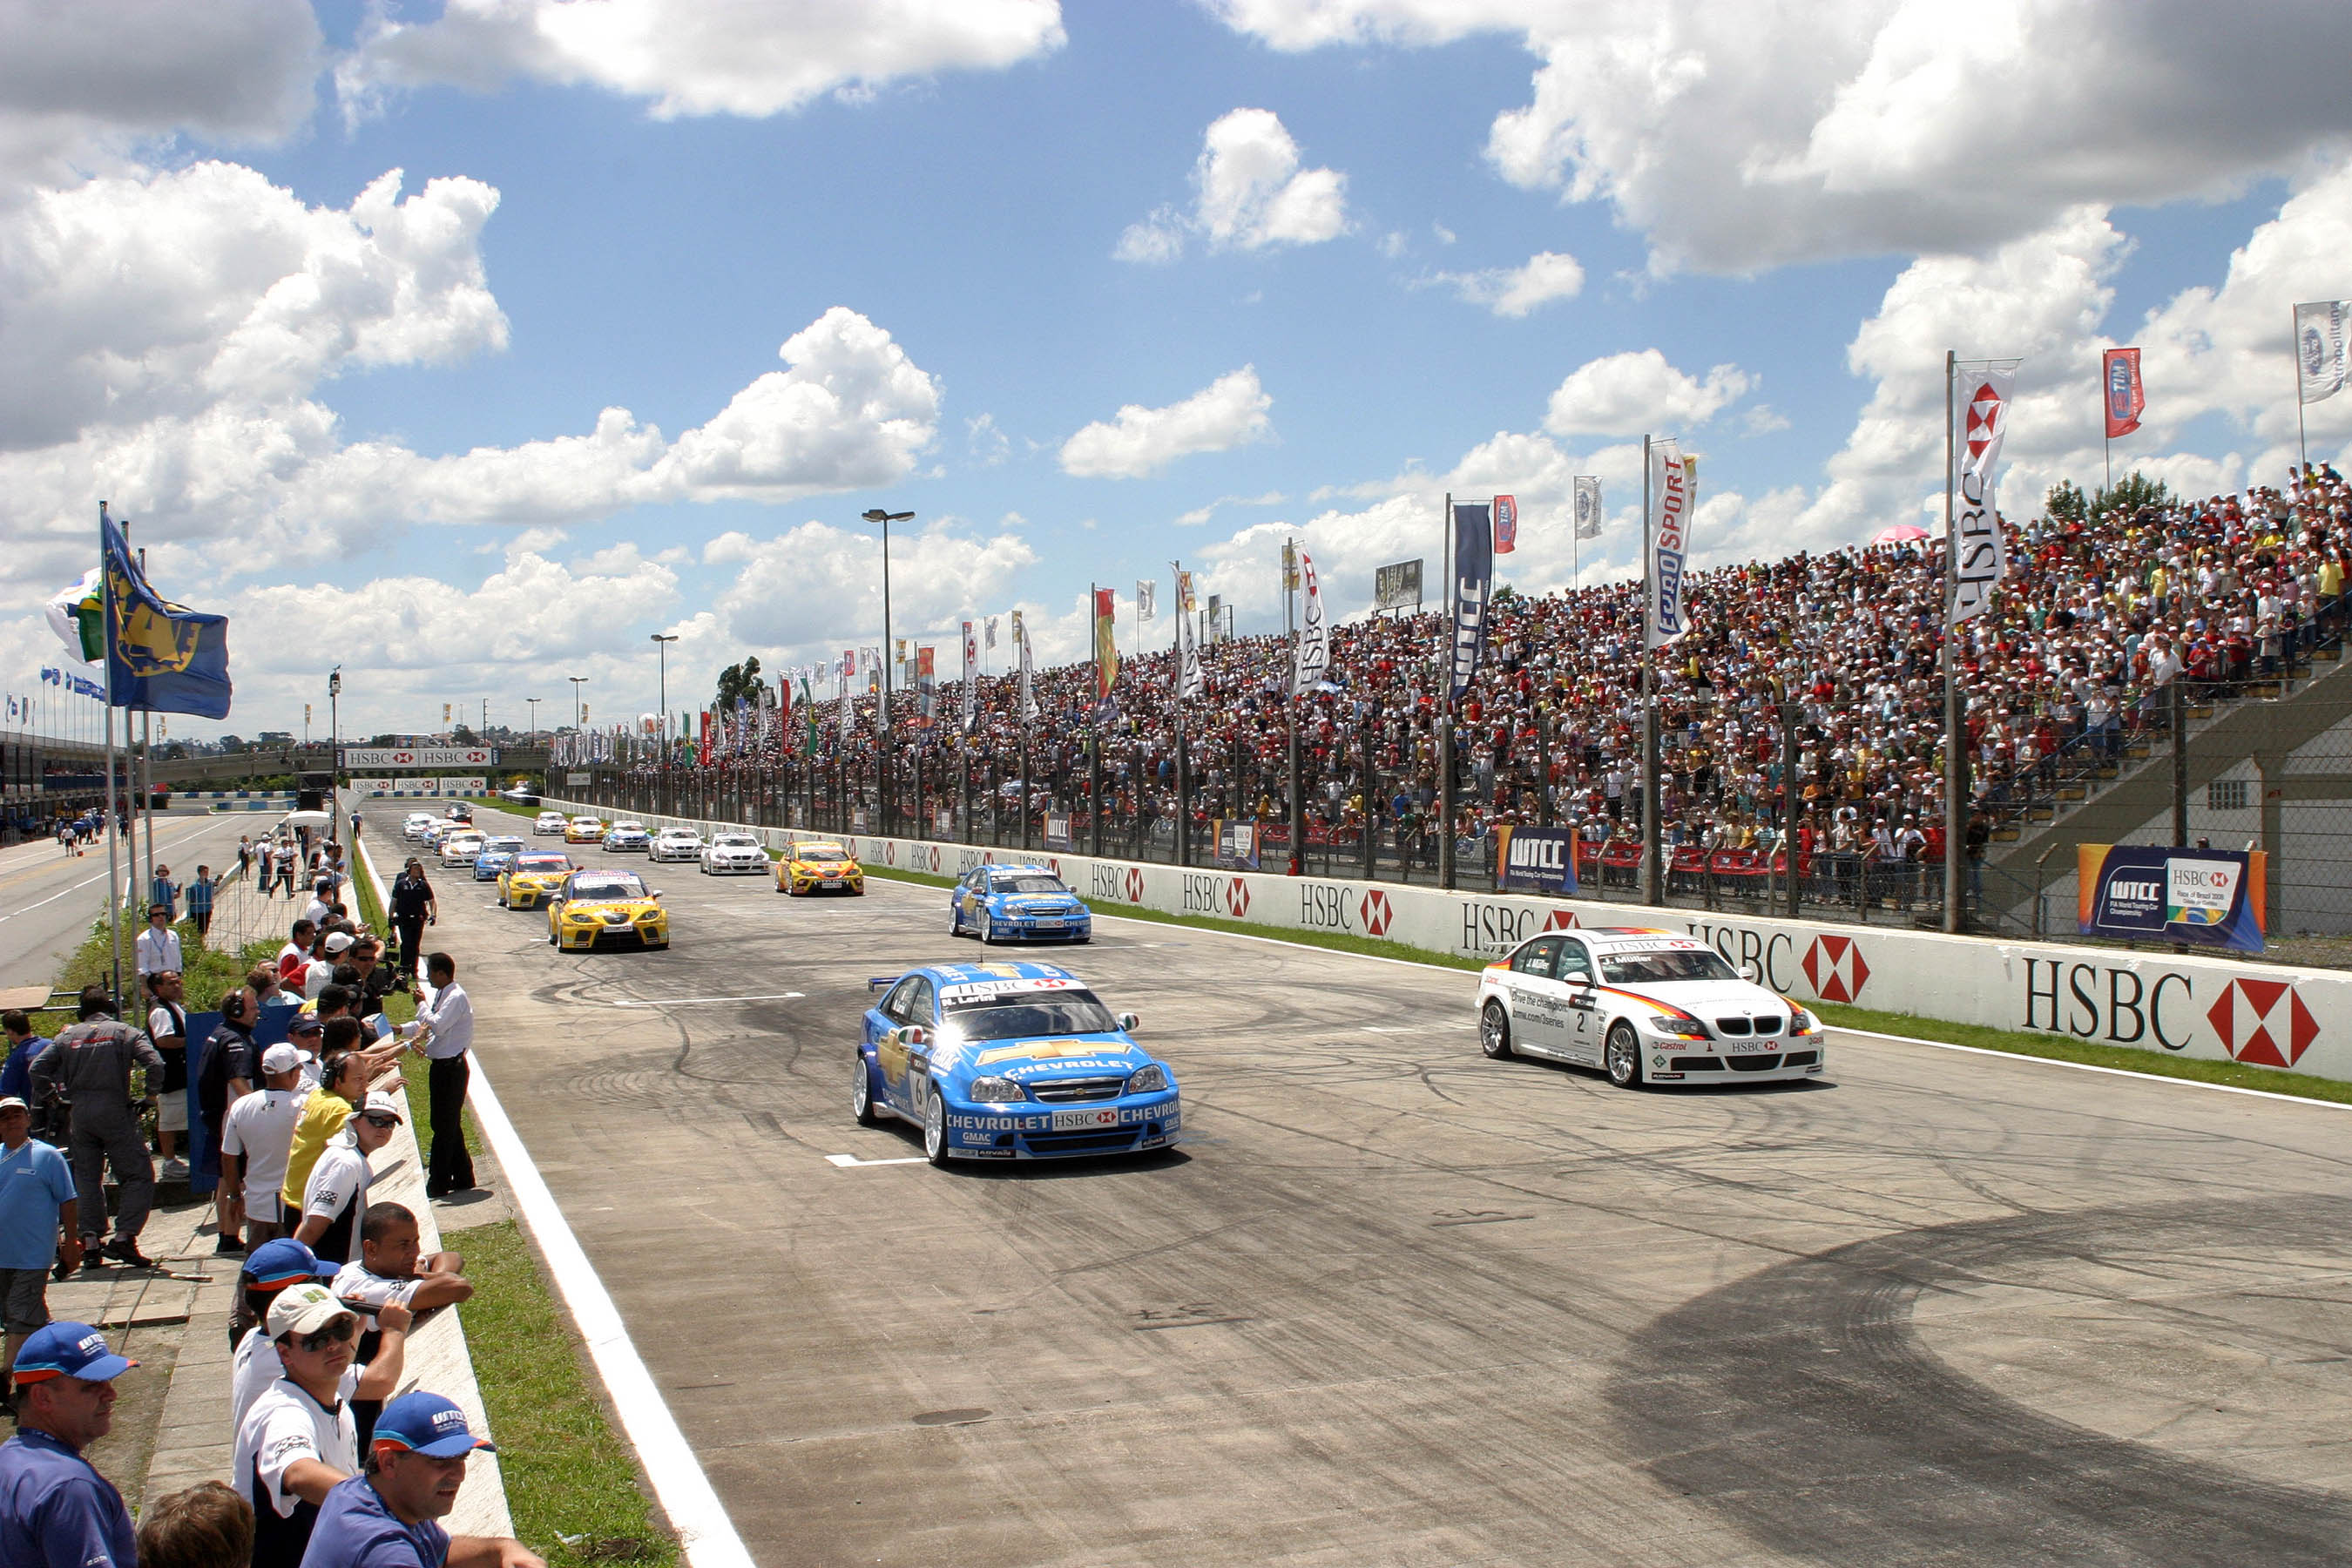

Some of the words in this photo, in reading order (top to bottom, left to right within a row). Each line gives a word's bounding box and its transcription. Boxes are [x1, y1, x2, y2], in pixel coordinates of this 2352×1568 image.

[2111, 365, 2126, 392] TIM
[1961, 473, 1996, 607] HSBC
[1301, 605, 1323, 685] HSBC
[351, 753, 391, 764] HSBC
[424, 752, 464, 763] HSBC
[1048, 819, 1068, 837] WTCC
[911, 844, 929, 871] HSBC
[1510, 838, 1565, 869] WTCC
[1092, 863, 1124, 900] HSBC
[2173, 870, 2208, 887] HSBC
[1183, 874, 1223, 913] HSBC
[2110, 881, 2160, 902] WTCC
[1301, 883, 1353, 929] HSBC
[1611, 941, 1667, 952] HSBC
[1603, 956, 1613, 965] J.
[1614, 955, 1652, 964] Müller
[958, 979, 1029, 995] HSBC
[942, 998, 957, 1007] N.
[1511, 990, 1526, 1004] Drive
[1527, 994, 1536, 1006] the
[2022, 957, 2193, 1051] HSBC
[1577, 1011, 1585, 1033] 2
[1659, 1042, 1687, 1051] Castrol
[1732, 1041, 1763, 1053] HSBC
[1004, 1059, 1134, 1079] CHEVROLET
[916, 1078, 923, 1105] 6
[947, 1114, 1050, 1131] CHEVROLET
[1054, 1112, 1096, 1127] HSBC
[963, 1132, 991, 1143] GMAC
